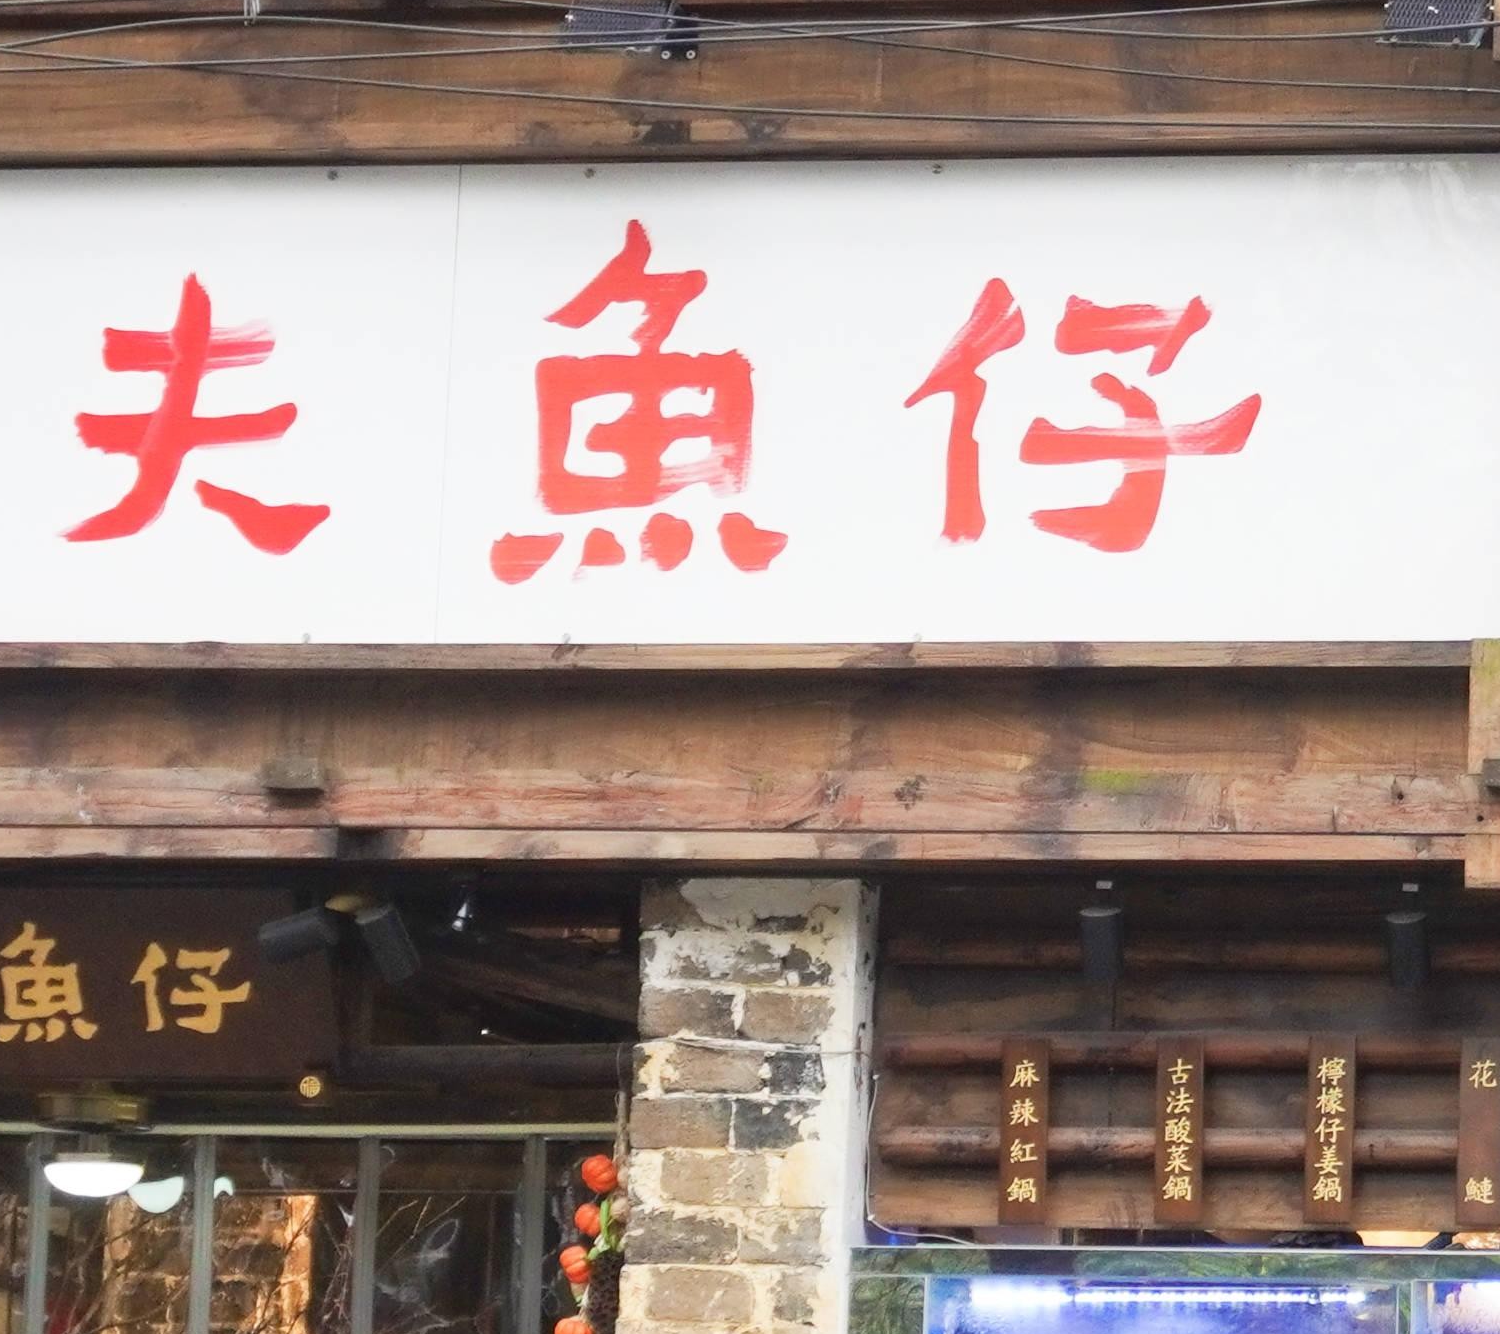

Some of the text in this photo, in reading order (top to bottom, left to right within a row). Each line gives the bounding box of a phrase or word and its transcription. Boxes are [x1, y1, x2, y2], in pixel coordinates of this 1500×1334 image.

[1006, 1059, 1040, 1204] 麻辣紅鍋
[1162, 1059, 1195, 1203] 古法酸菜鍋
[1312, 1057, 1346, 1204] 檸檬仔姜鍋
[1464, 1061, 1498, 1205] 花鰱
